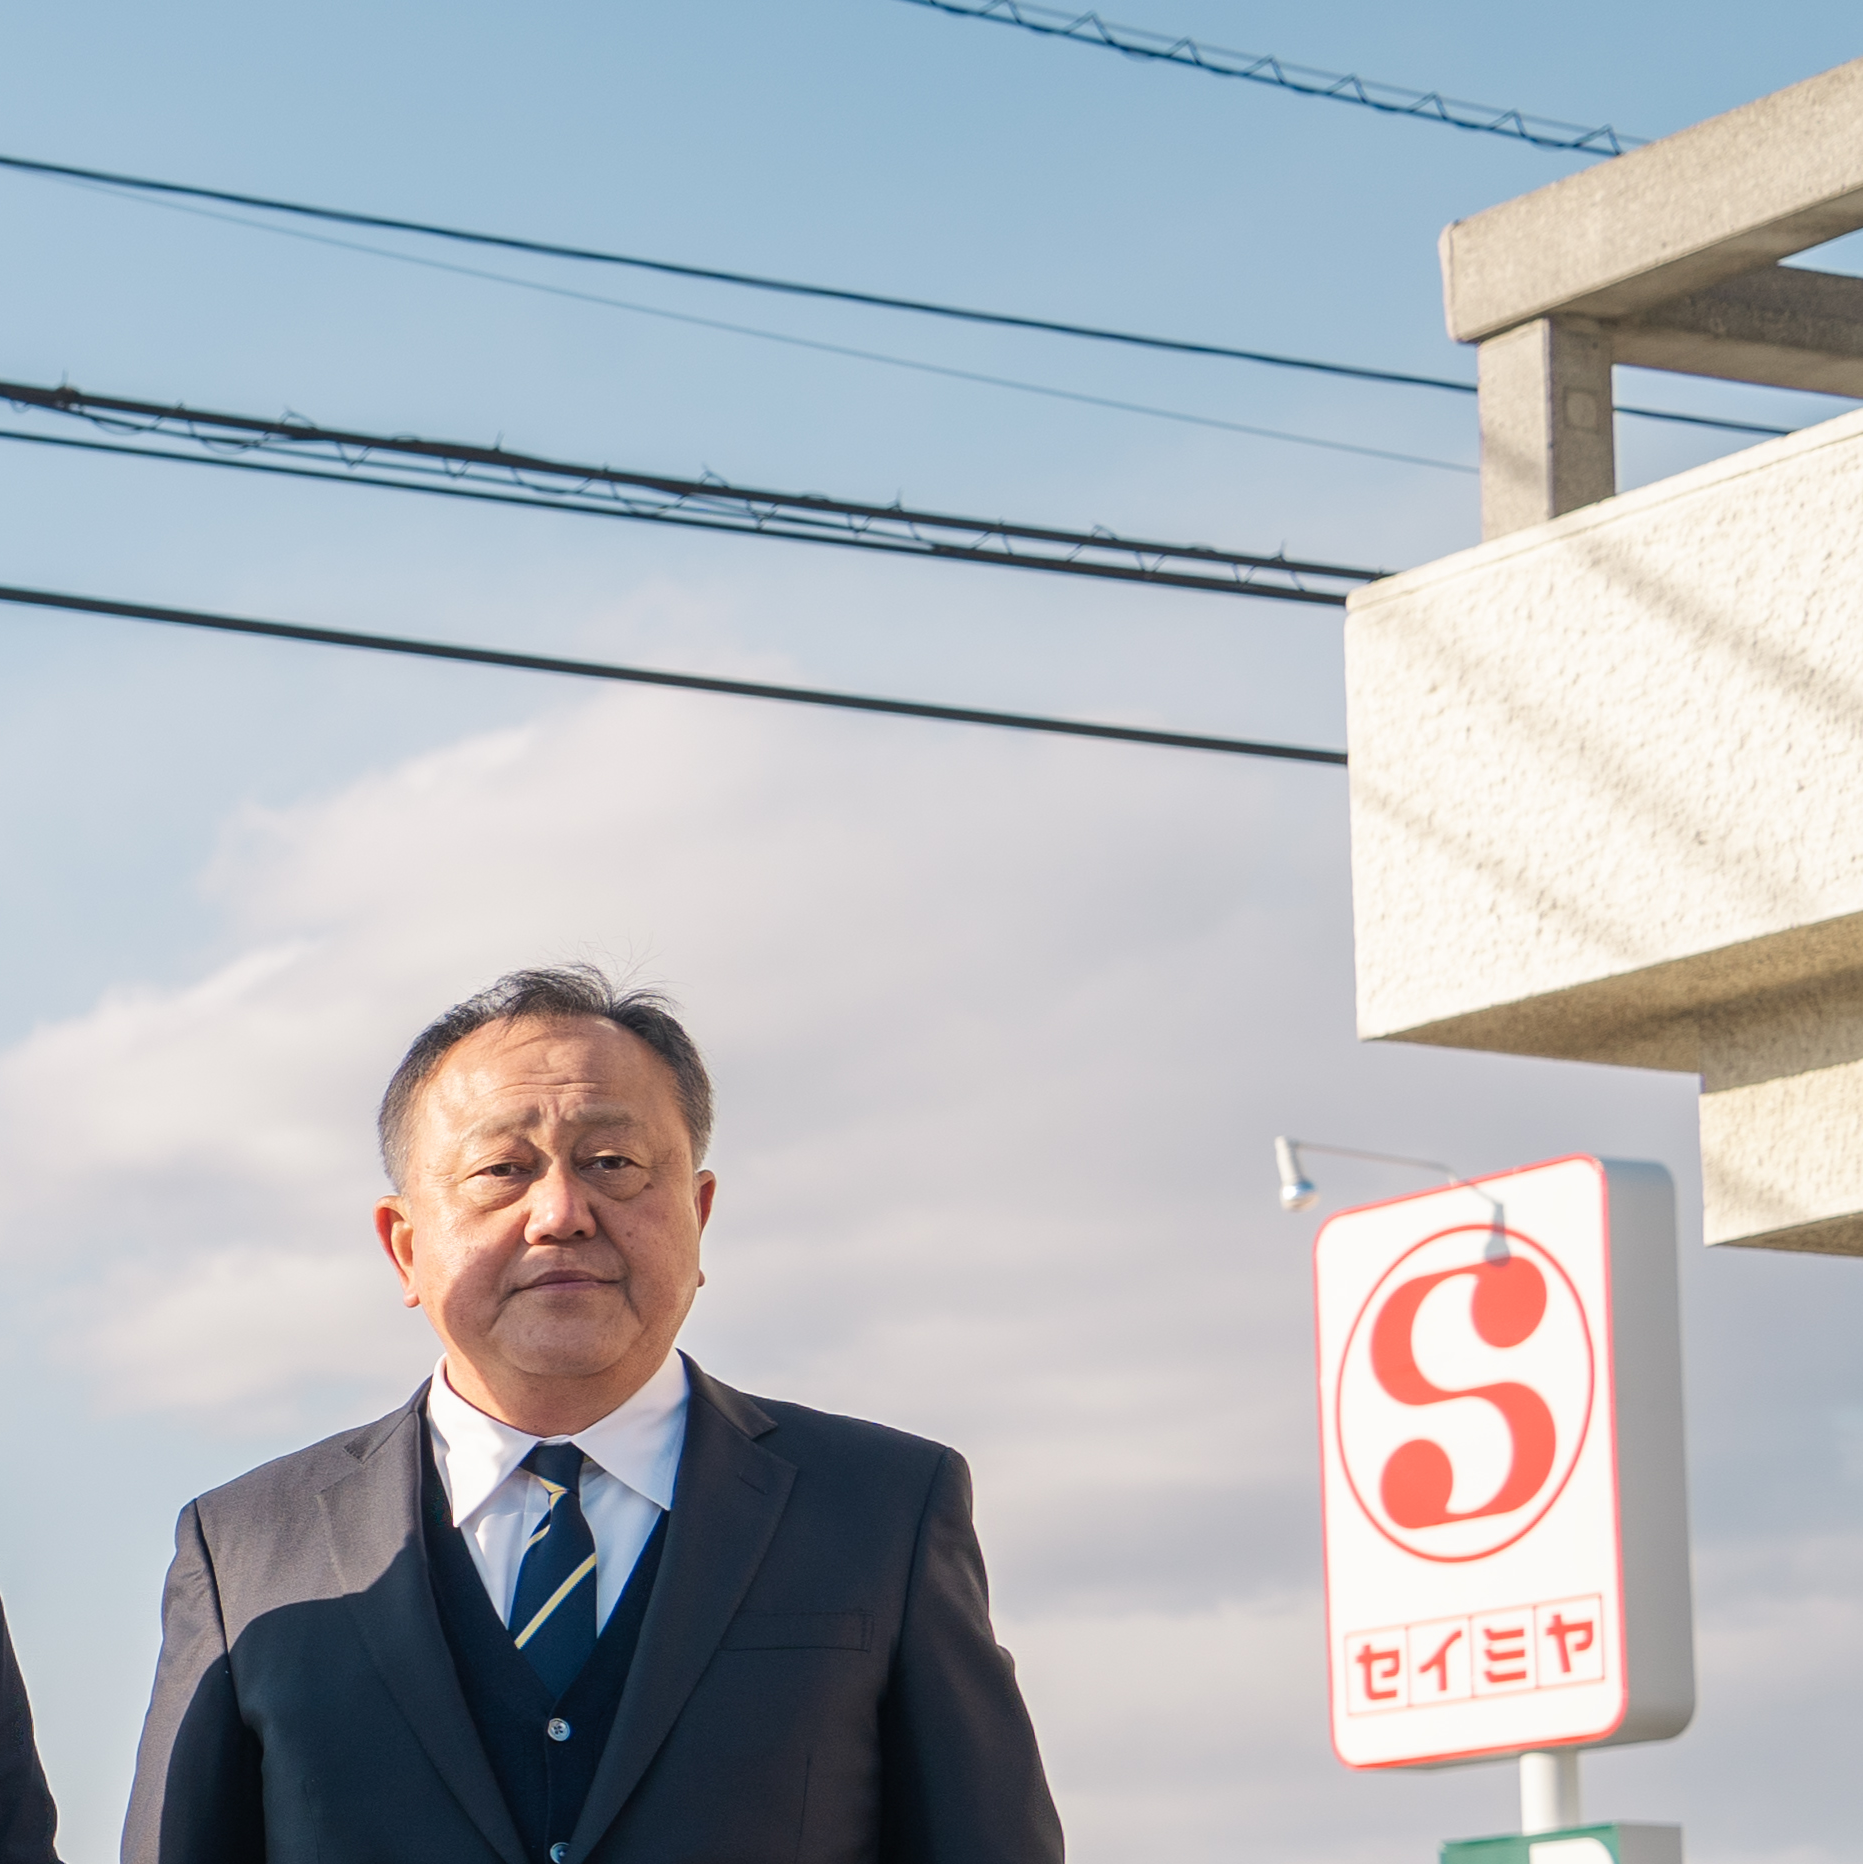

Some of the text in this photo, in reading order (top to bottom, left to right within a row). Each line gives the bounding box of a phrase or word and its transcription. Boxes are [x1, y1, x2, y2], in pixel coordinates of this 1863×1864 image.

[1369, 1255, 1557, 1531] S
[1354, 1613, 1594, 1701] セイミヤ
